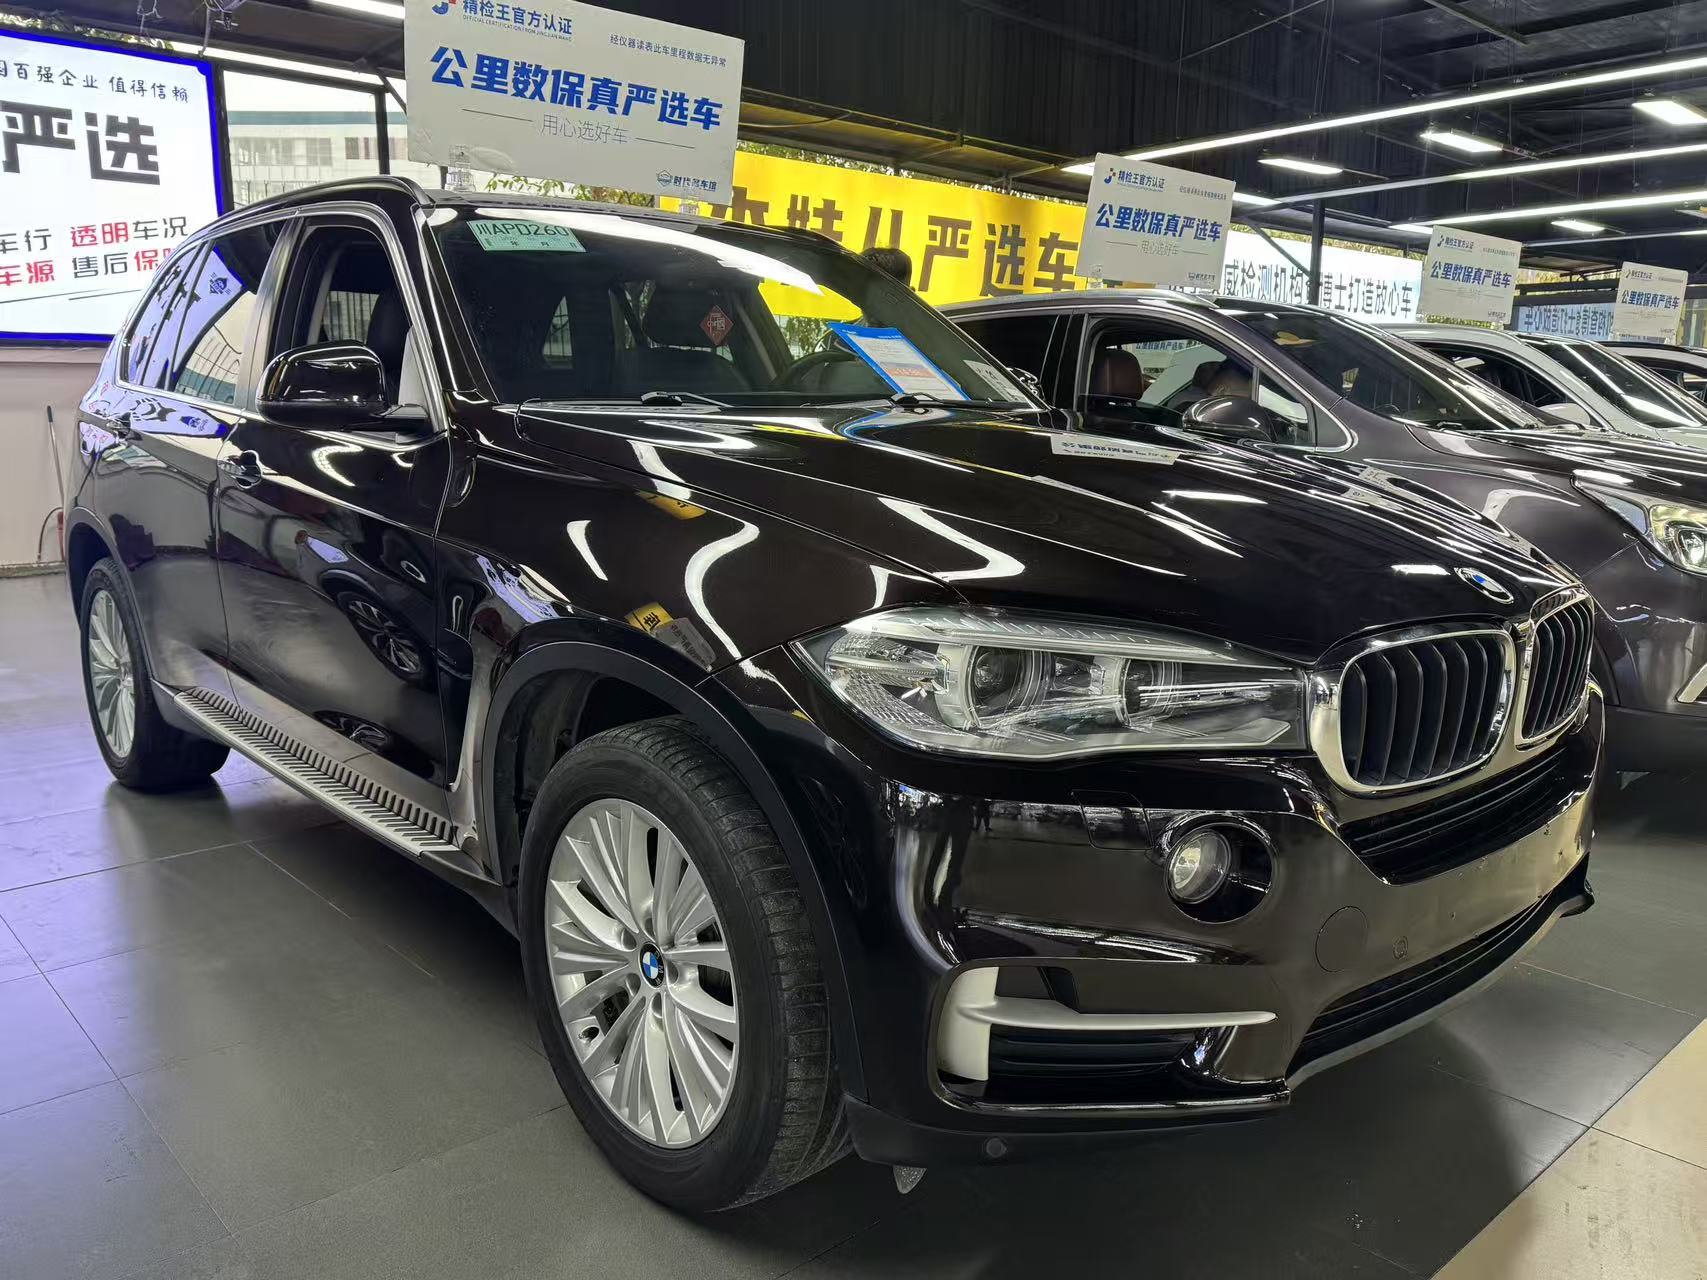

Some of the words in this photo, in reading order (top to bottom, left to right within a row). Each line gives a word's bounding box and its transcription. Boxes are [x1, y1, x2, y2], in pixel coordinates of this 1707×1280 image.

[463, 0, 573, 35] 精检王官方认证
[610, 34, 727, 67] 经仪器读表此车里程数据无异常
[109, 76, 189, 103] 值得信赖
[430, 46, 724, 131] 公里数保真严选车
[0, 99, 160, 185] 严选
[541, 113, 628, 145] 用心选好车
[1117, 170, 1166, 189] 精检王官方认证
[0, 228, 52, 253] 车行
[70, 216, 188, 248] 透明车况
[476, 223, 570, 237] 川APD260
[1095, 203, 1223, 243] 公里数保真严选车
[0, 259, 55, 287] 车源
[1223, 258, 1414, 319] 威检测机构博士打造放心车
[1431, 260, 1512, 289] 公里数保真严选车
[1621, 289, 1680, 310] 公里数保真严选车
